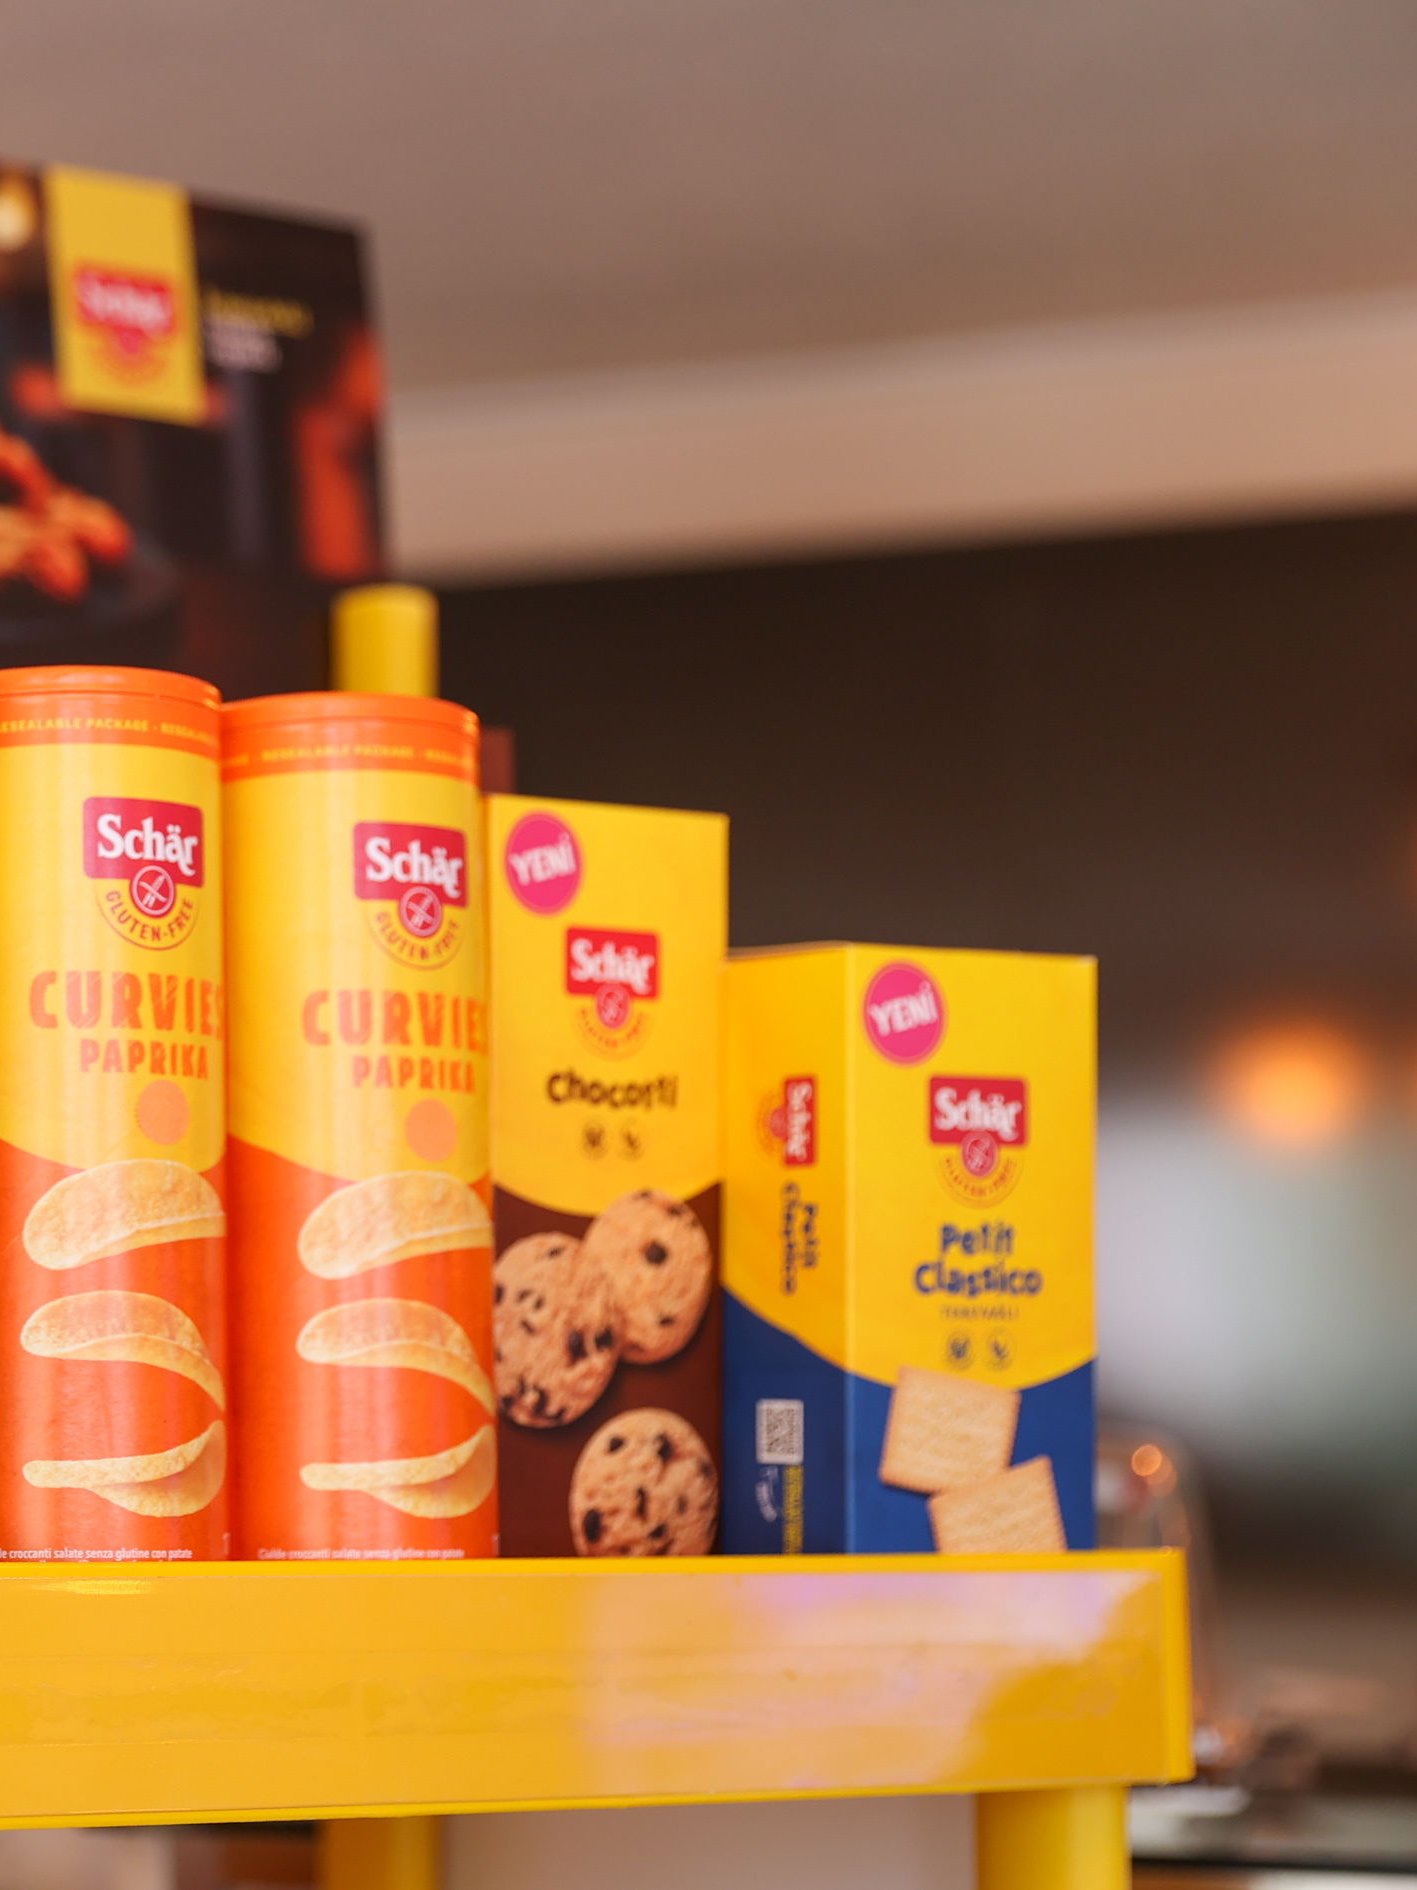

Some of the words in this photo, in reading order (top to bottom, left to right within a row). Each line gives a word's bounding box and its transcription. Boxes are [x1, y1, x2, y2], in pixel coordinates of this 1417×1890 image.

[86, 717, 149, 732] PACKAGE
[97, 814, 198, 876] Schär
[365, 836, 463, 898] Schär
[105, 890, 194, 943] GLUTEN-FREE
[375, 912, 460, 960] GLUTEN-FREE
[570, 938, 655, 995] Schär
[81, 1039, 208, 1080] PAPRIKA
[352, 1055, 475, 1095] PAPRIKA
[934, 1087, 1022, 1141] Schär
[942, 1223, 1014, 1255] Petit
[914, 1260, 1042, 1296] Classico
[9, 1548, 51, 1559] croccanti
[53, 1548, 83, 1559] salate
[86, 1550, 113, 1559] senza
[115, 1548, 149, 1561] glutine
[151, 1550, 167, 1559] con
